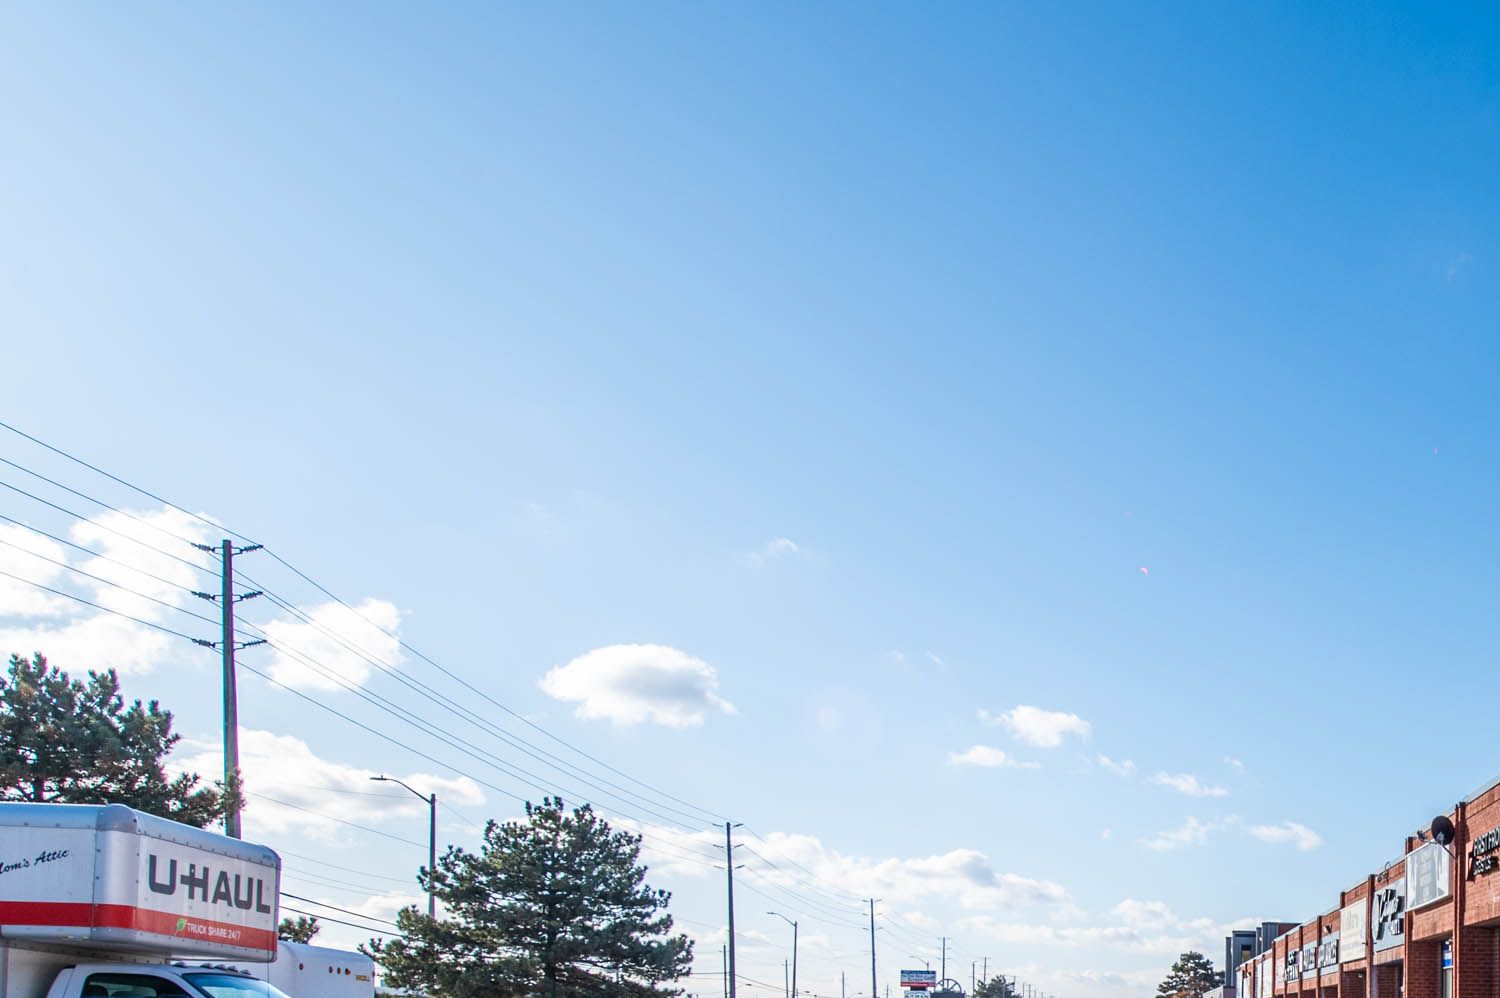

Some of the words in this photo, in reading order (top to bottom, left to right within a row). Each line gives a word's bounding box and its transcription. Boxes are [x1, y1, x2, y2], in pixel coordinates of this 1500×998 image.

[0, 859, 30, 875] om's
[33, 849, 71, 867] Attic
[187, 922, 207, 935] TRUCK
[207, 925, 228, 938] SHARE
[228, 928, 241, 940] 24/7
